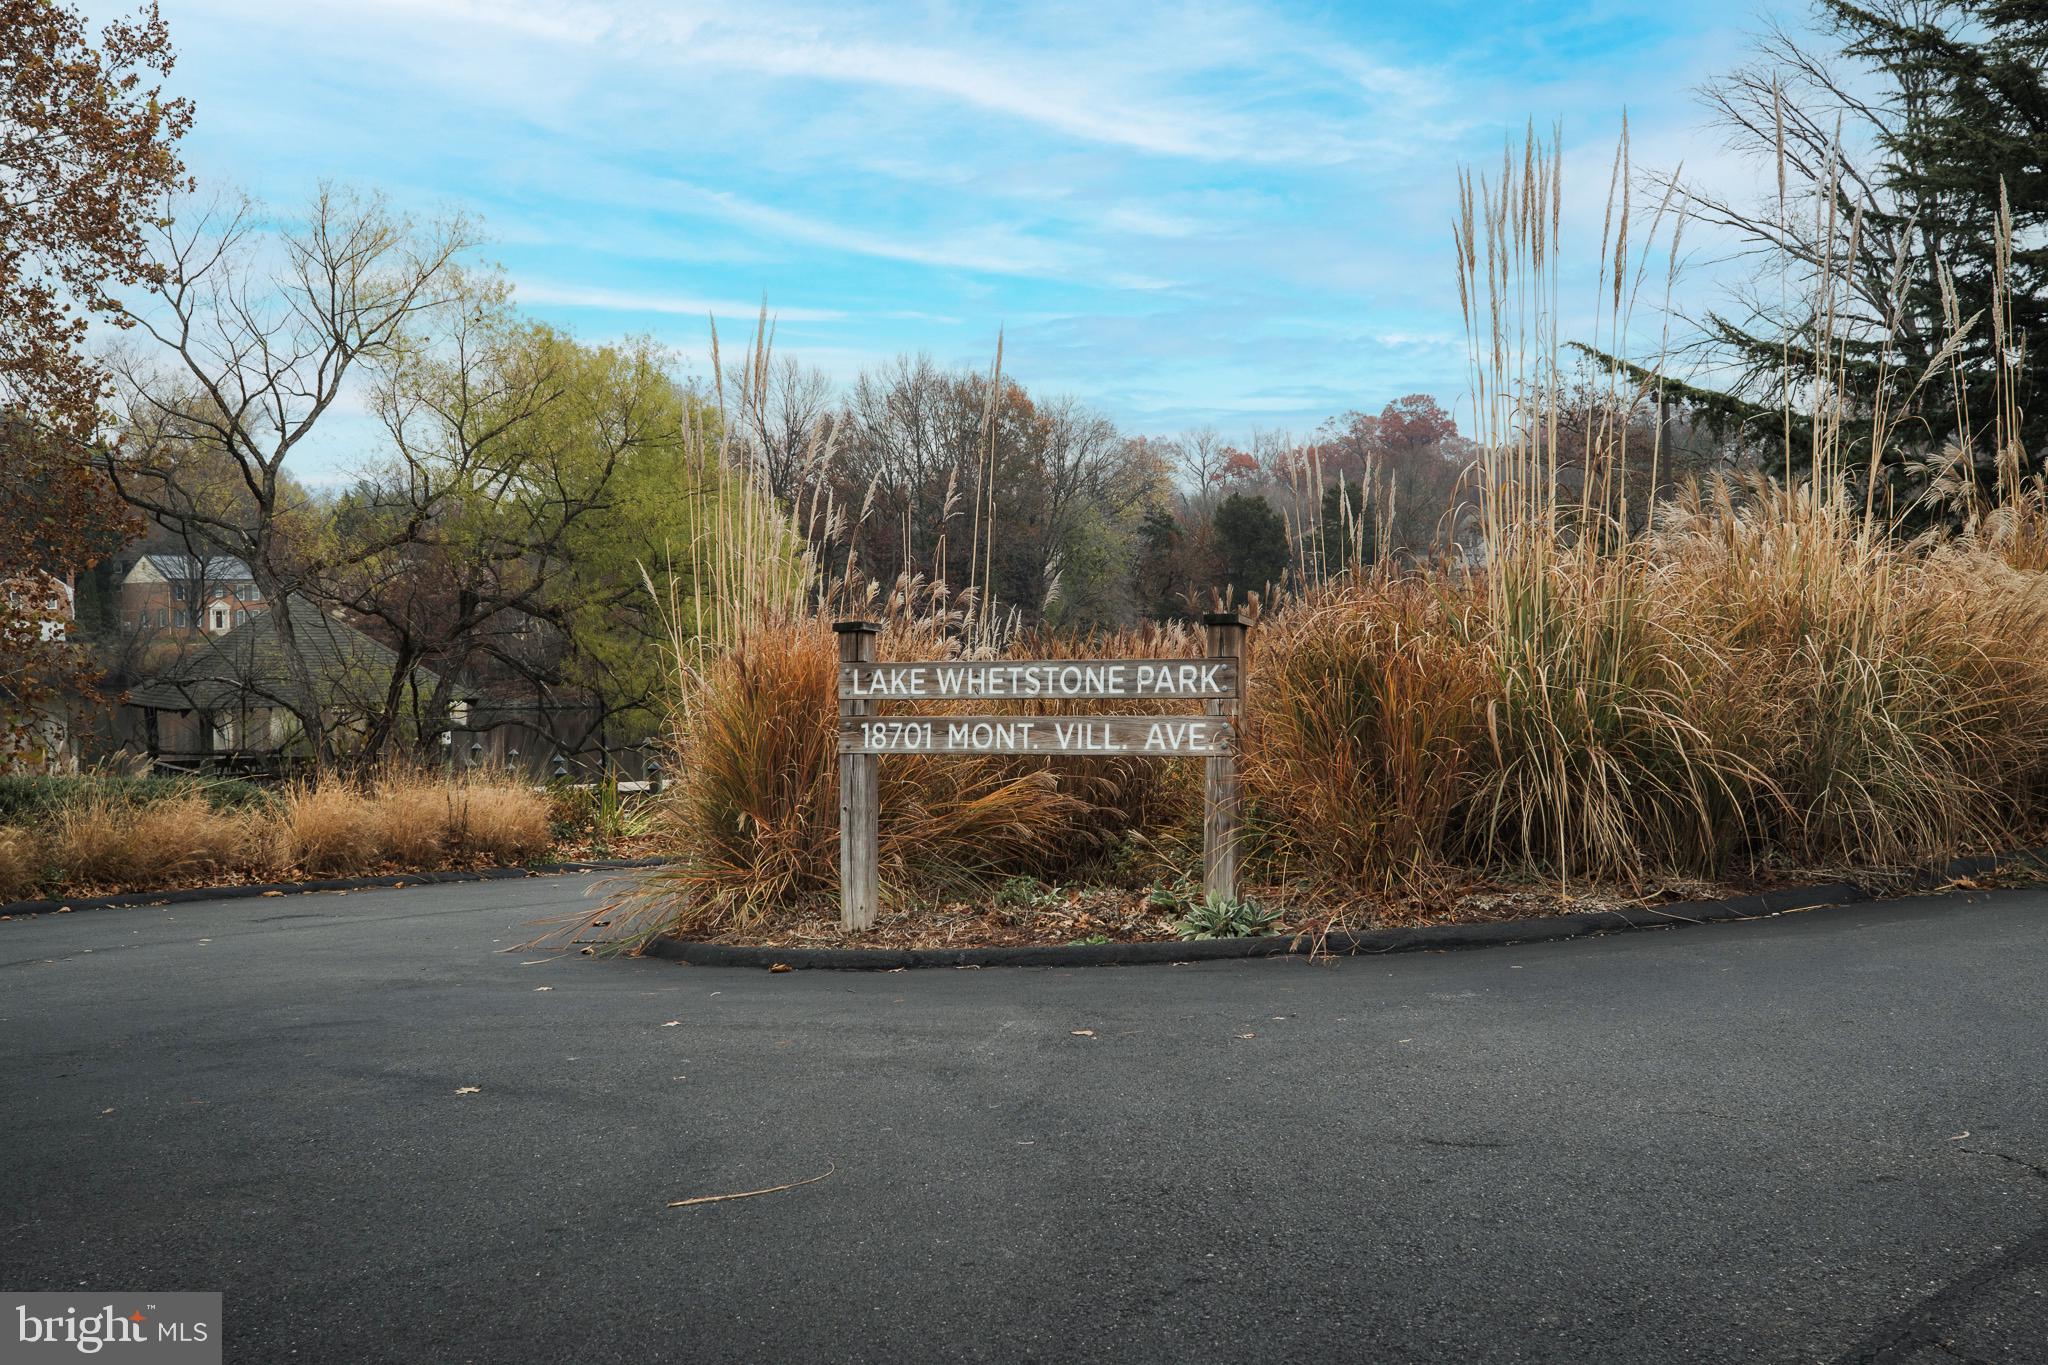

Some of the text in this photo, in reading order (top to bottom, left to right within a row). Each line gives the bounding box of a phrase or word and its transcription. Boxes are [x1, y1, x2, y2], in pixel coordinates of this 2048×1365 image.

[853, 665, 1220, 695] LAKE WHETSTONE PARK
[861, 722, 1214, 750] 18701 MONT. VILL. AVE.
